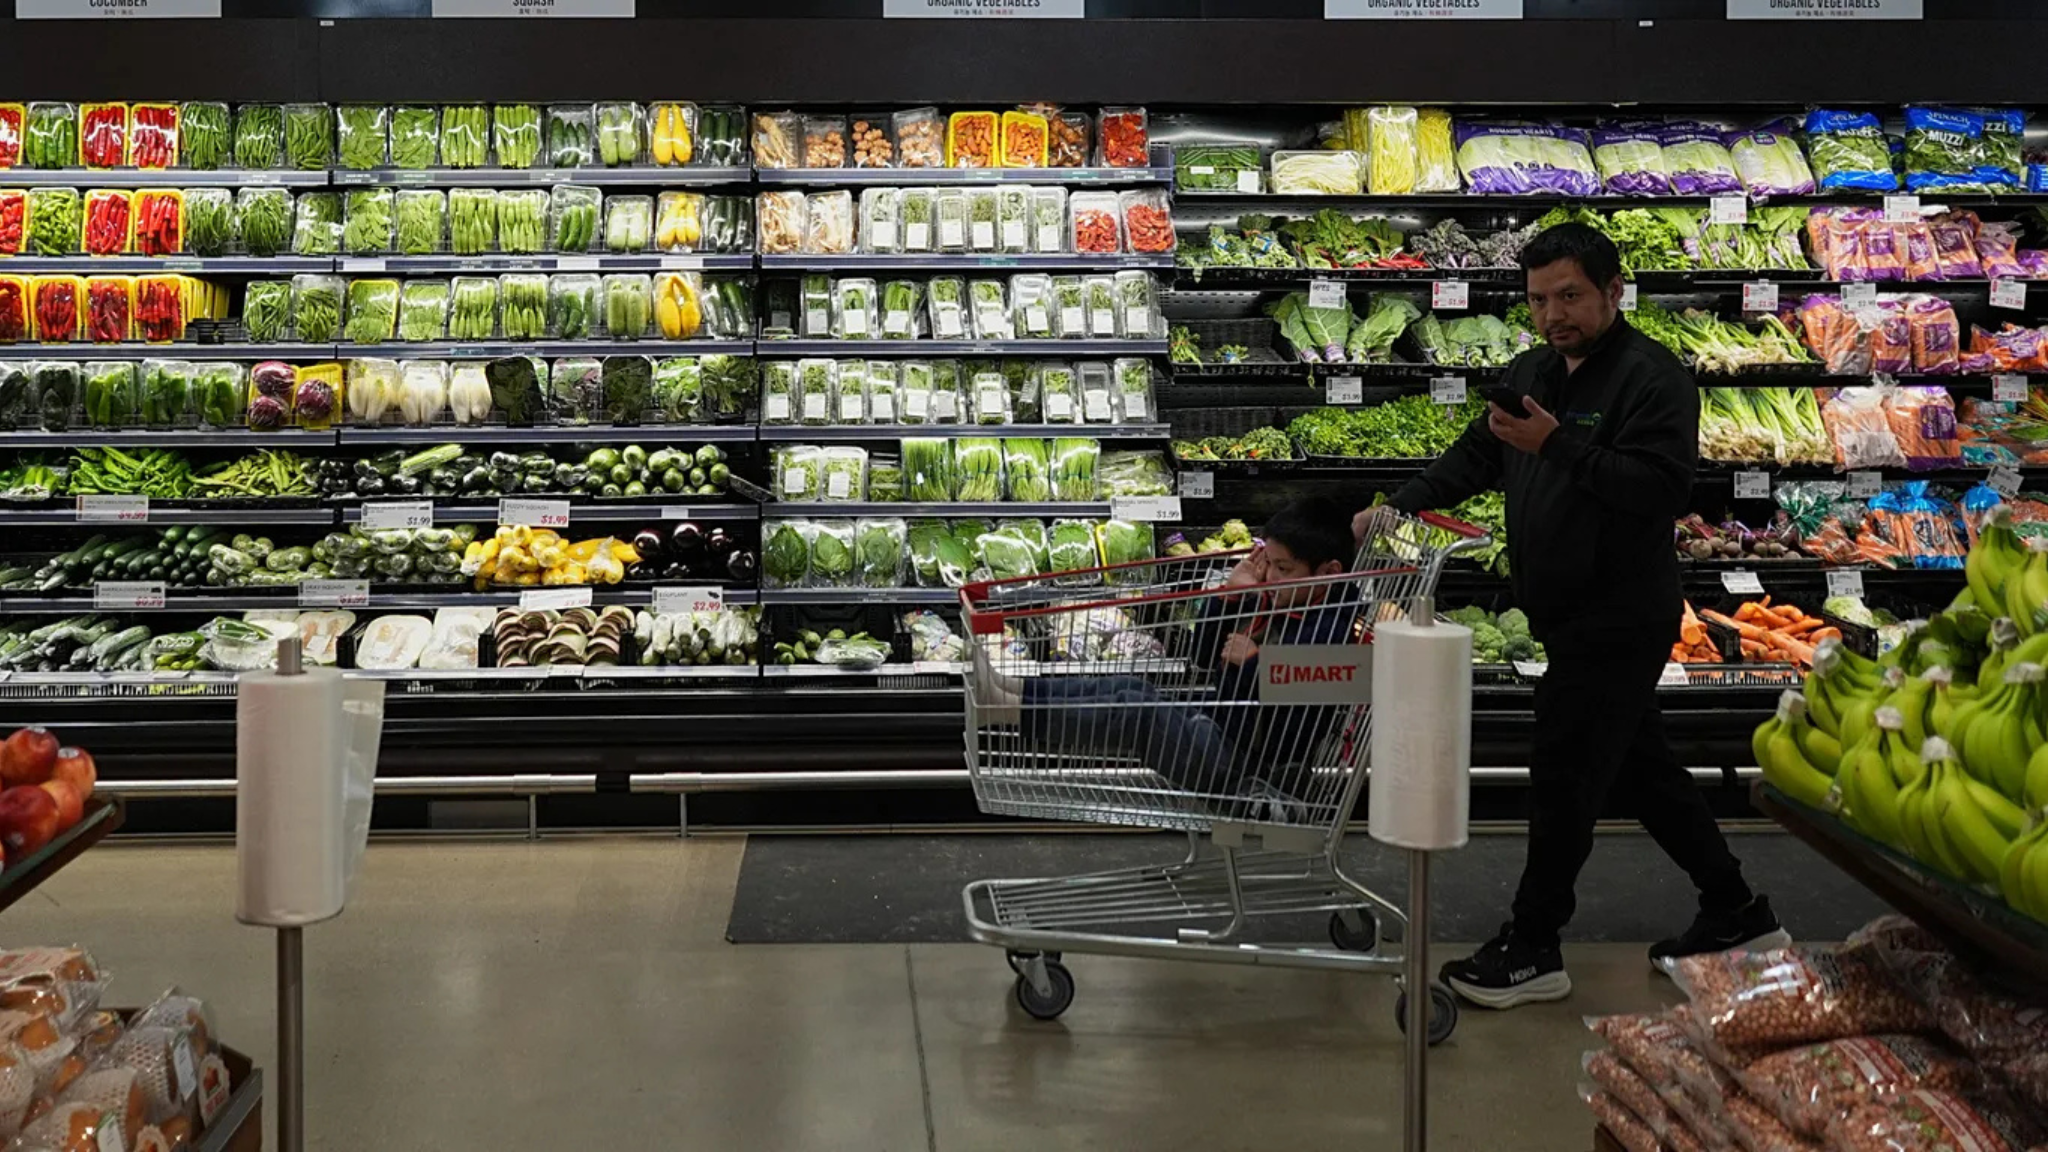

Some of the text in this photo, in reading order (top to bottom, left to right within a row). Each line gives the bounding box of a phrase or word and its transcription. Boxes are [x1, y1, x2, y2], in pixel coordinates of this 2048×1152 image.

[1367, 0, 1480, 8] ORGANIC VEGETABLES
[1769, 0, 1881, 8] ORGANIC VEGETABLES
[1156, 509, 1180, 518] $1.99
[407, 515, 431, 525] $1.99
[541, 514, 567, 524] $1.99
[692, 600, 721, 611] $2.99
[1293, 665, 1357, 682] MART
[1508, 965, 1537, 984] HOKA
